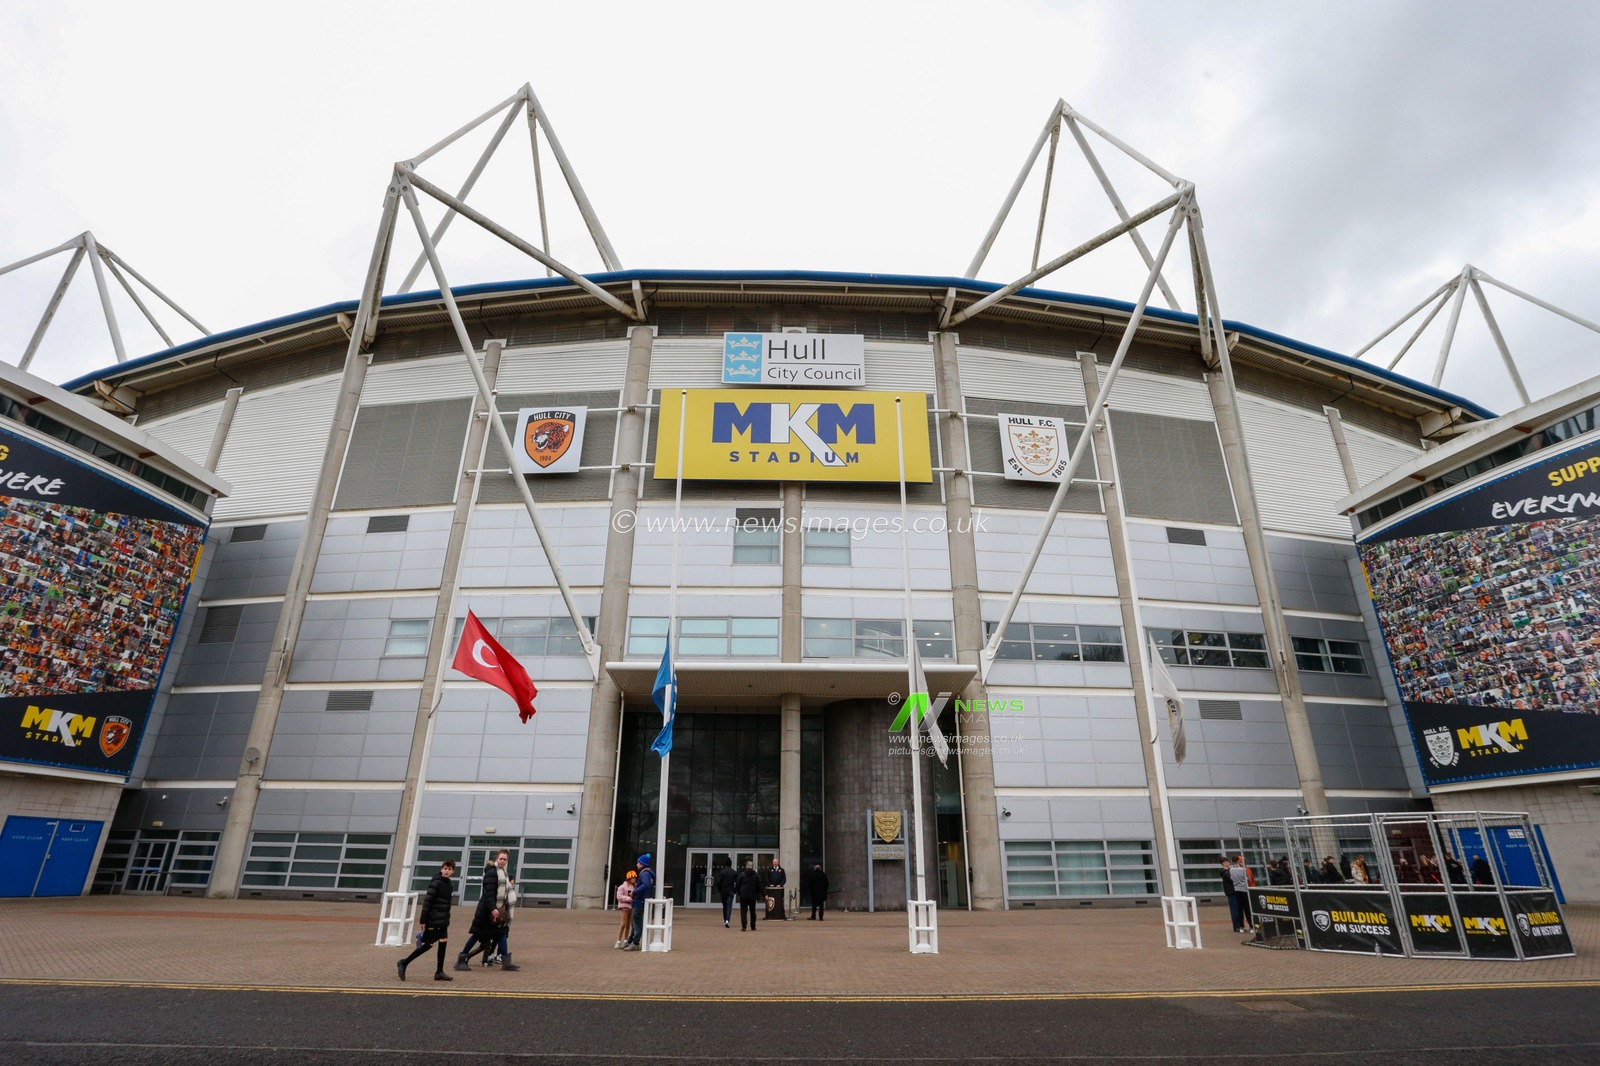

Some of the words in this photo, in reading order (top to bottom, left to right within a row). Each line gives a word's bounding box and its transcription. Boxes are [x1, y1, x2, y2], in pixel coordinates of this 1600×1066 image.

[768, 338, 825, 359] Hull
[767, 367, 798, 382] City
[804, 367, 861, 380] Council
[533, 412, 551, 420] HULL
[712, 402, 876, 444] MKM
[1008, 417, 1033, 425] HULL
[729, 451, 859, 463] STADIUM
[1008, 458, 1023, 476] Est.
[1052, 460, 1067, 478] 1865
[20, 705, 96, 747] MKM
[1456, 718, 1528, 753] MKM
[1266, 896, 1288, 905] BUILDING
[1331, 911, 1388, 924] BUILDING
[1410, 915, 1452, 932] MKM
[1527, 912, 1560, 925] BUILDING
[1334, 924, 1347, 932] ON
[1350, 925, 1390, 935] SUCCESS
[1463, 917, 1506, 935] MKM
[1541, 925, 1562, 935] HISTORY
